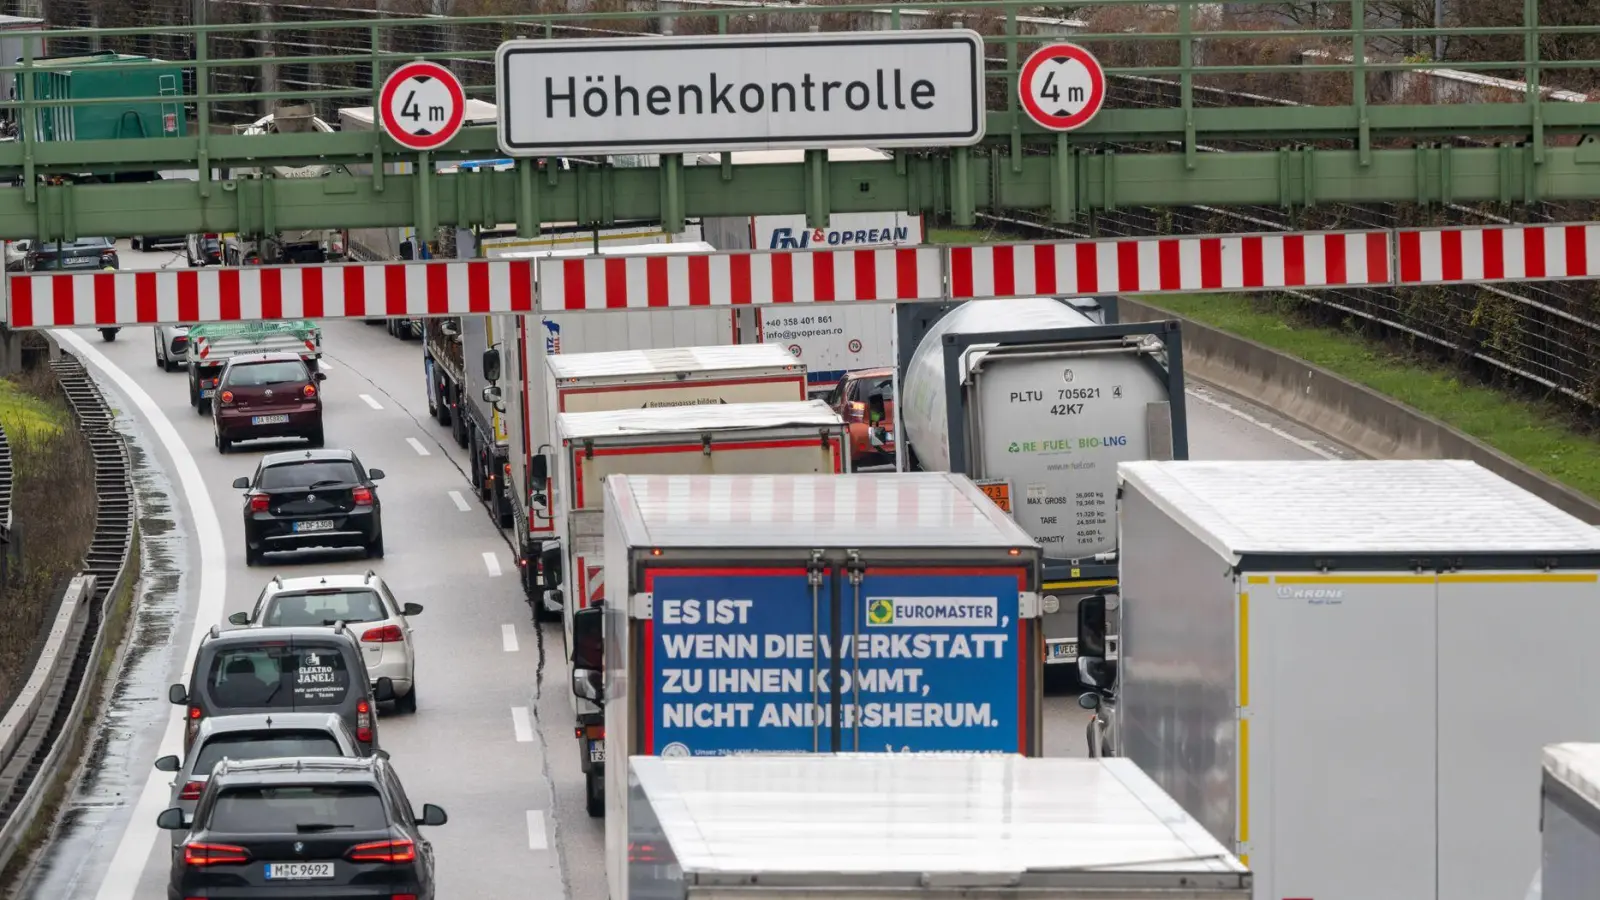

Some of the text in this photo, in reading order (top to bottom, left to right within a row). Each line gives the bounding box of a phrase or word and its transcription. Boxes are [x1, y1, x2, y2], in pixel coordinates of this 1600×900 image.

[1040, 70, 1084, 102] 4 m
[544, 68, 936, 119] Höhenkontrolle
[400, 90, 445, 121] 4 m
[827, 227, 908, 245] OPREAN
[766, 315, 833, 327] +40 358 401 861
[766, 327, 843, 340] info@gvoprean.ro
[1010, 386, 1122, 402] PLTU 705621 4
[1050, 403, 1084, 416] 42K7
[1078, 435, 1127, 448] BIO-LNG
[980, 486, 1002, 497] 23
[1044, 496, 1067, 505] GROSS
[1040, 516, 1058, 524] TARE
[1033, 535, 1065, 543] CAPACITY
[1293, 588, 1346, 598] KRONE
[662, 599, 701, 625] ES
[706, 599, 753, 625] IST
[895, 605, 993, 619] EUROMASTER
[662, 633, 1009, 659] WENN DIE WERKSTATT
[298, 666, 333, 674] ELEKTRO
[662, 668, 703, 693] ZU
[708, 668, 803, 693] IHNEN
[662, 703, 754, 728] NICHT
[300, 864, 329, 876] 9692
